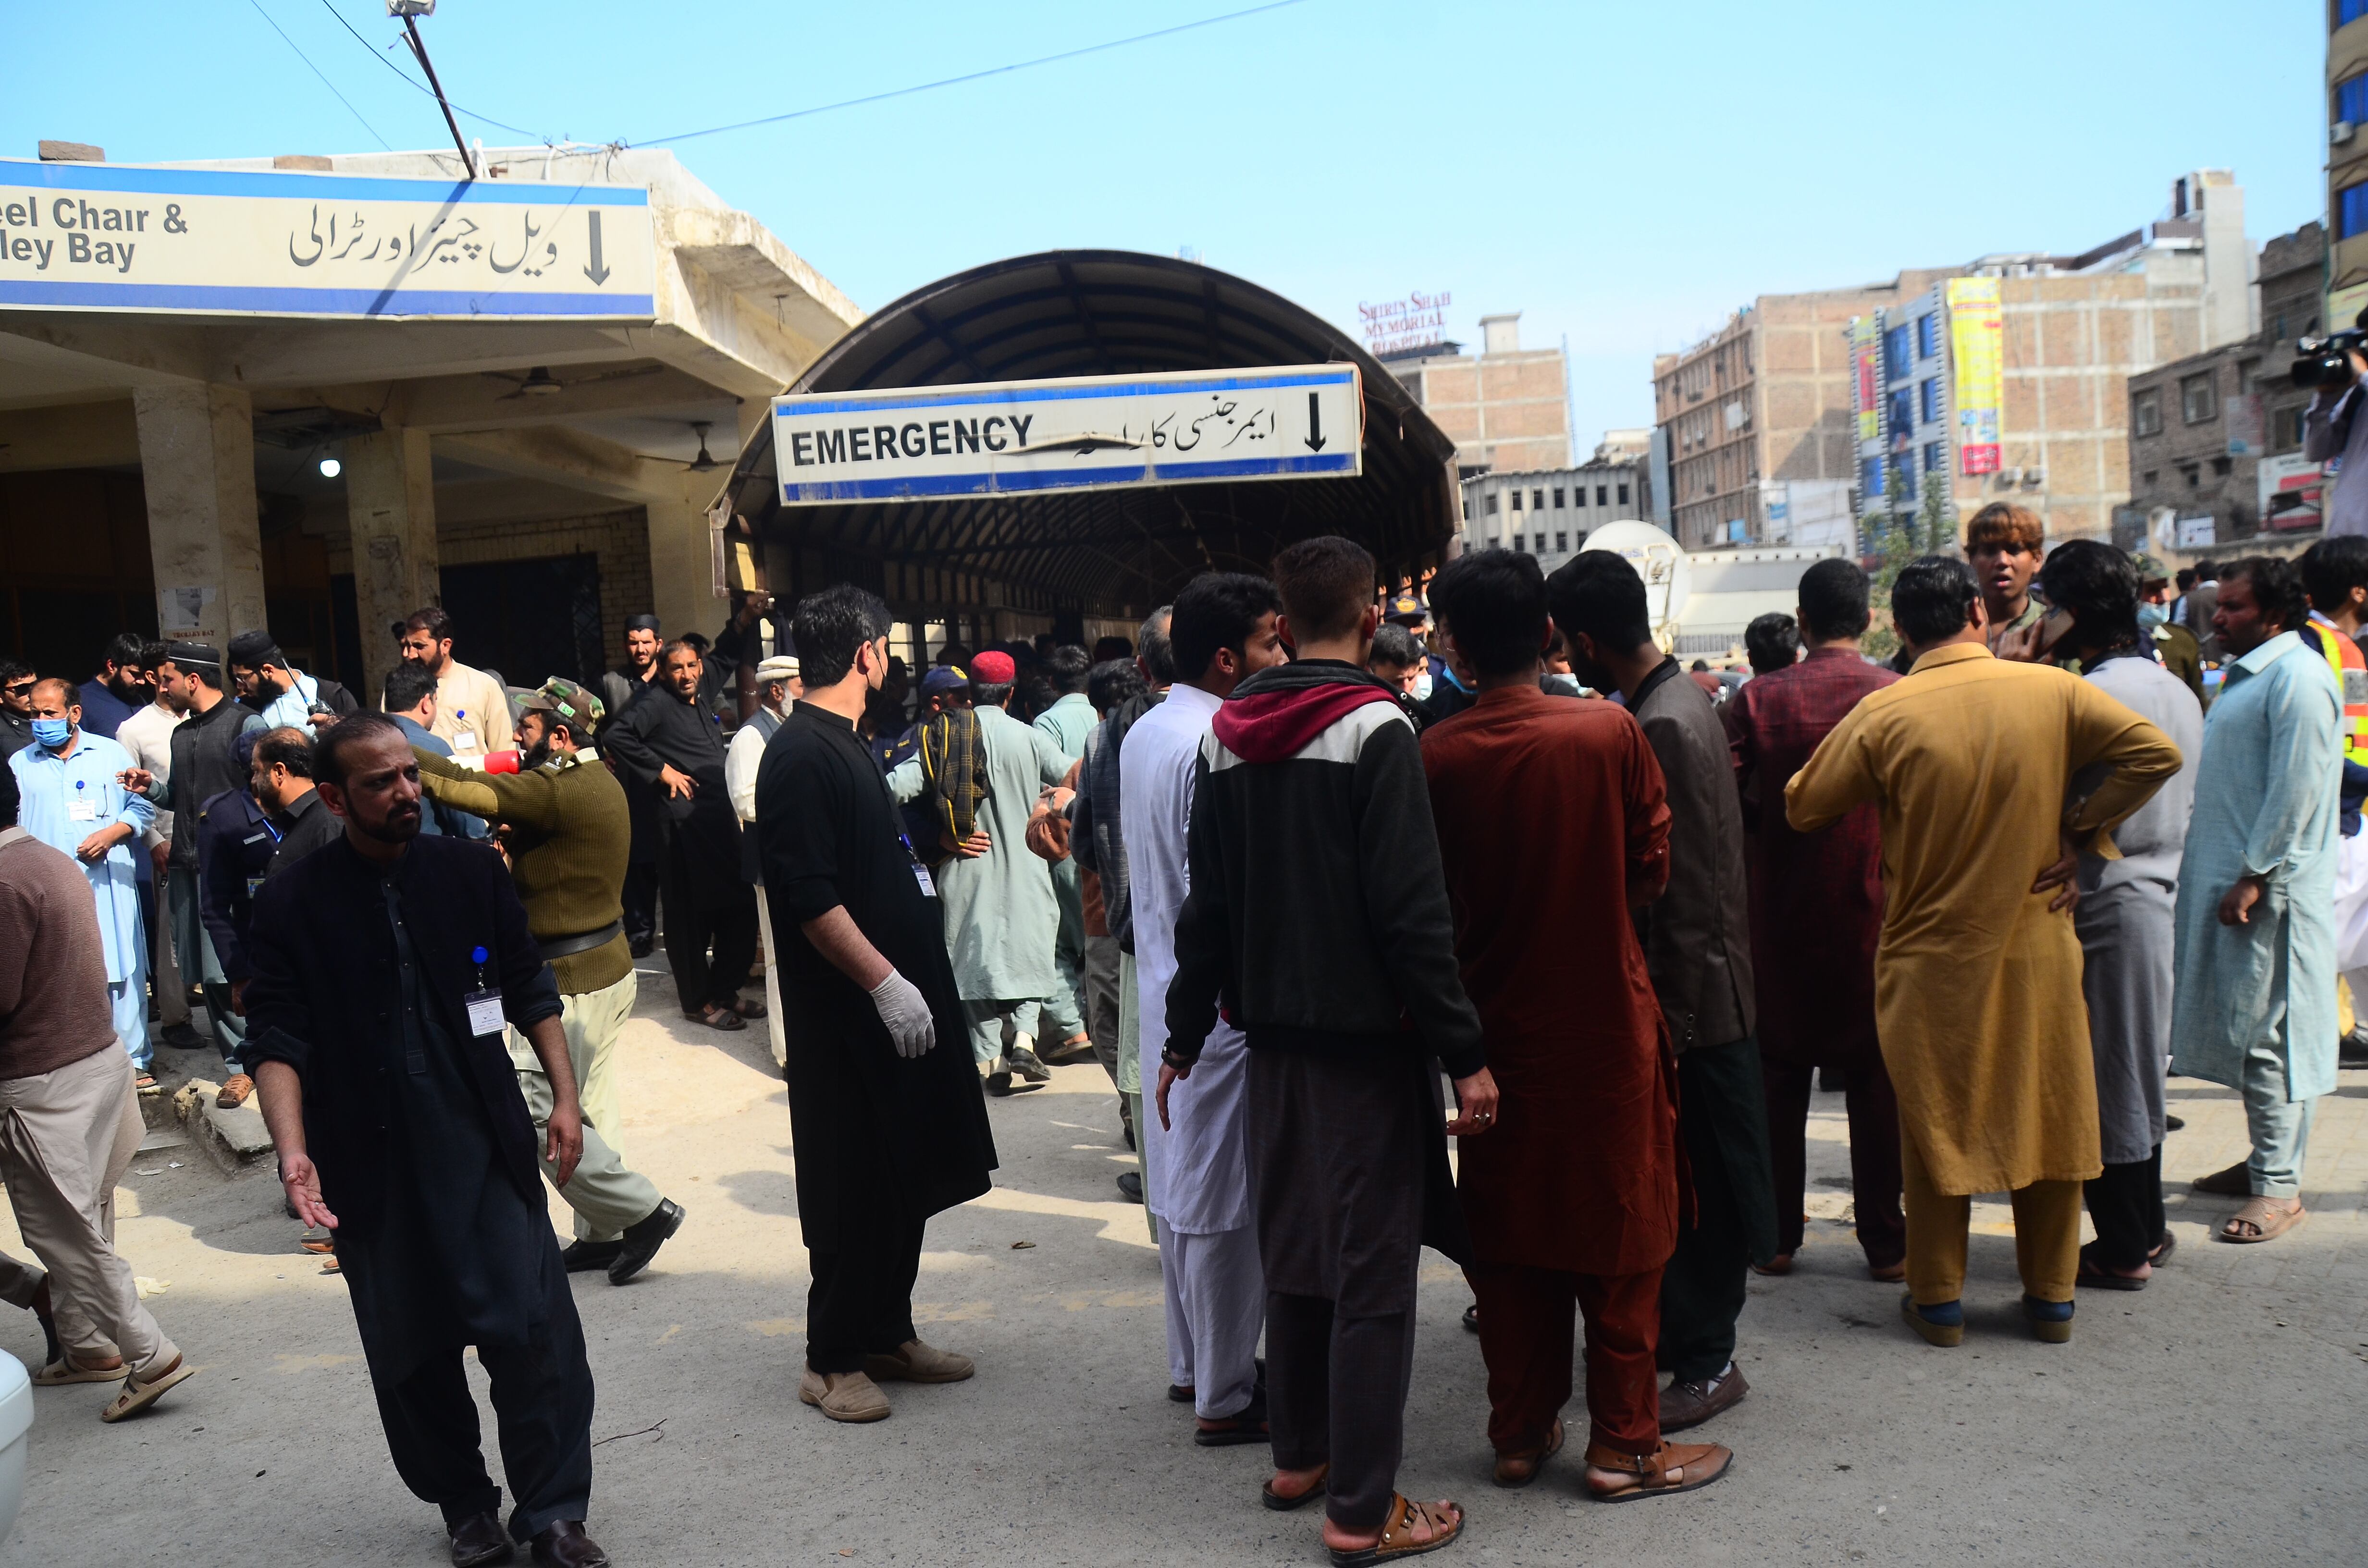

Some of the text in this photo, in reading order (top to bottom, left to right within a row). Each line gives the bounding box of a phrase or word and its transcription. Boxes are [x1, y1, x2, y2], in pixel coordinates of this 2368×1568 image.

[0, 196, 188, 234] el Chair &
[69, 233, 135, 273] Bay
[360, 223, 415, 262] اور
[490, 209, 556, 277] ویل
[791, 414, 1034, 466] EMERGENCY
